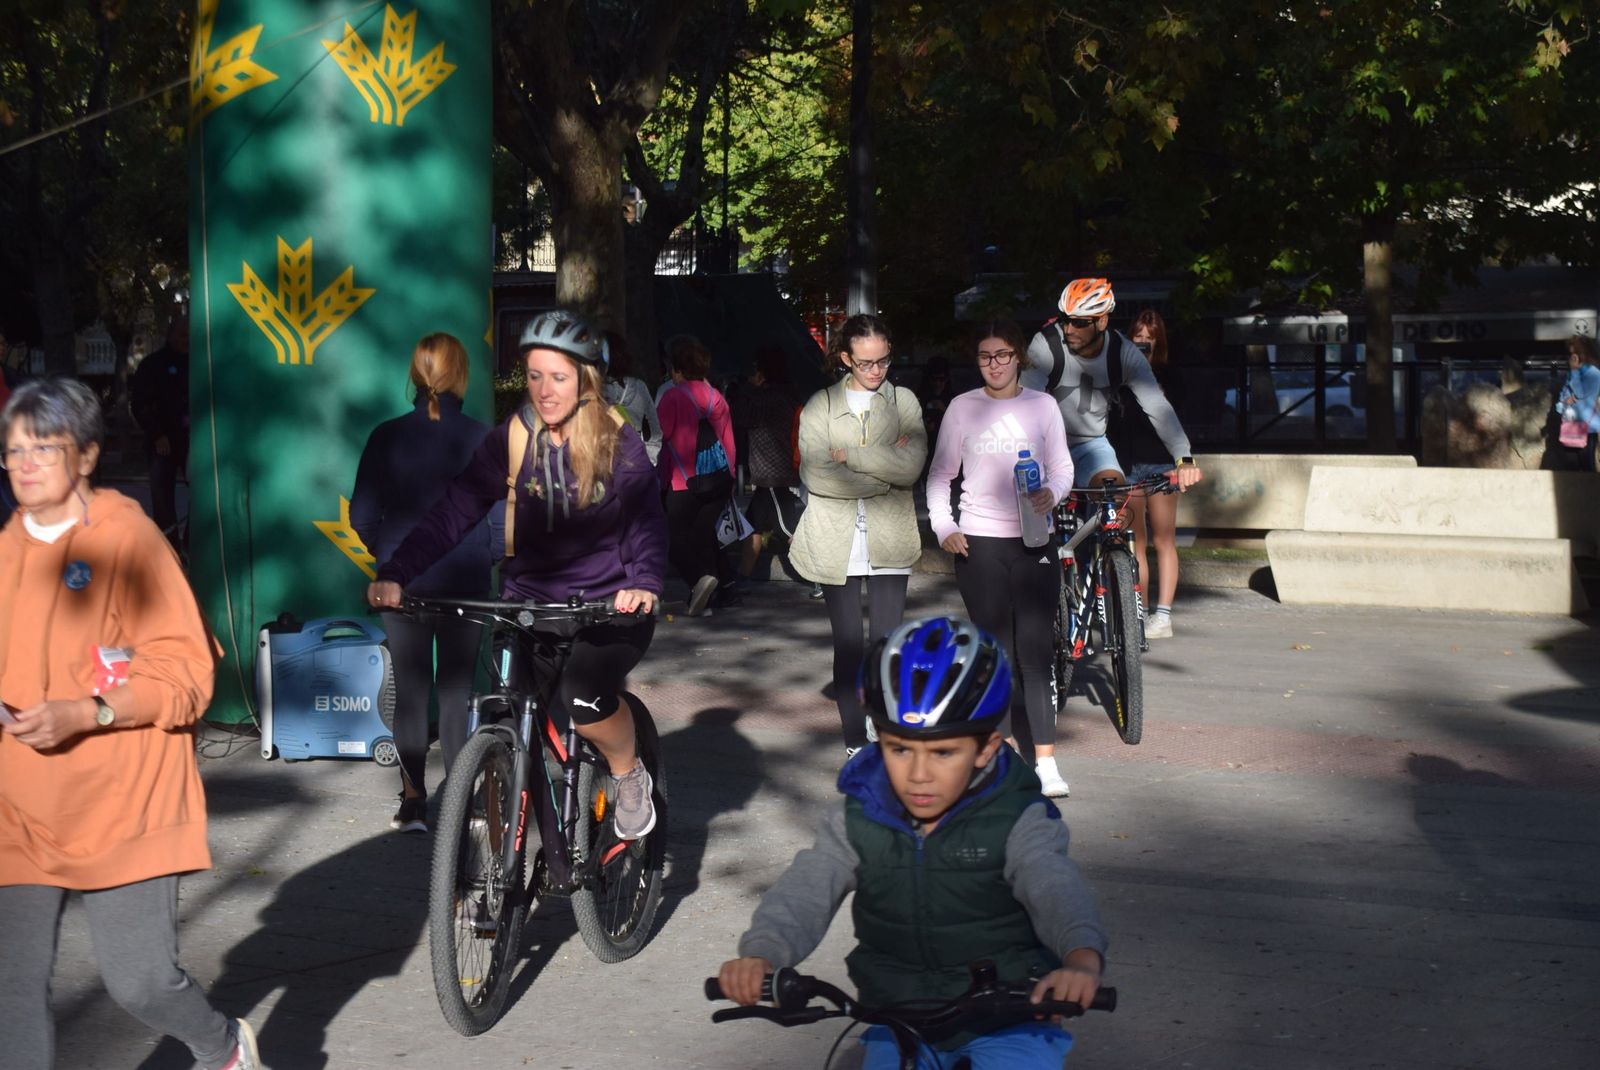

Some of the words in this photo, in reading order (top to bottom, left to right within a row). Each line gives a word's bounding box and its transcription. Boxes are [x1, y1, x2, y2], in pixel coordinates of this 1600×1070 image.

[1307, 323, 1328, 342] LA
[1403, 322, 1431, 342] DE
[1437, 321, 1487, 341] ORO
[974, 437, 1036, 455] adidas
[332, 695, 371, 712] SDMO
